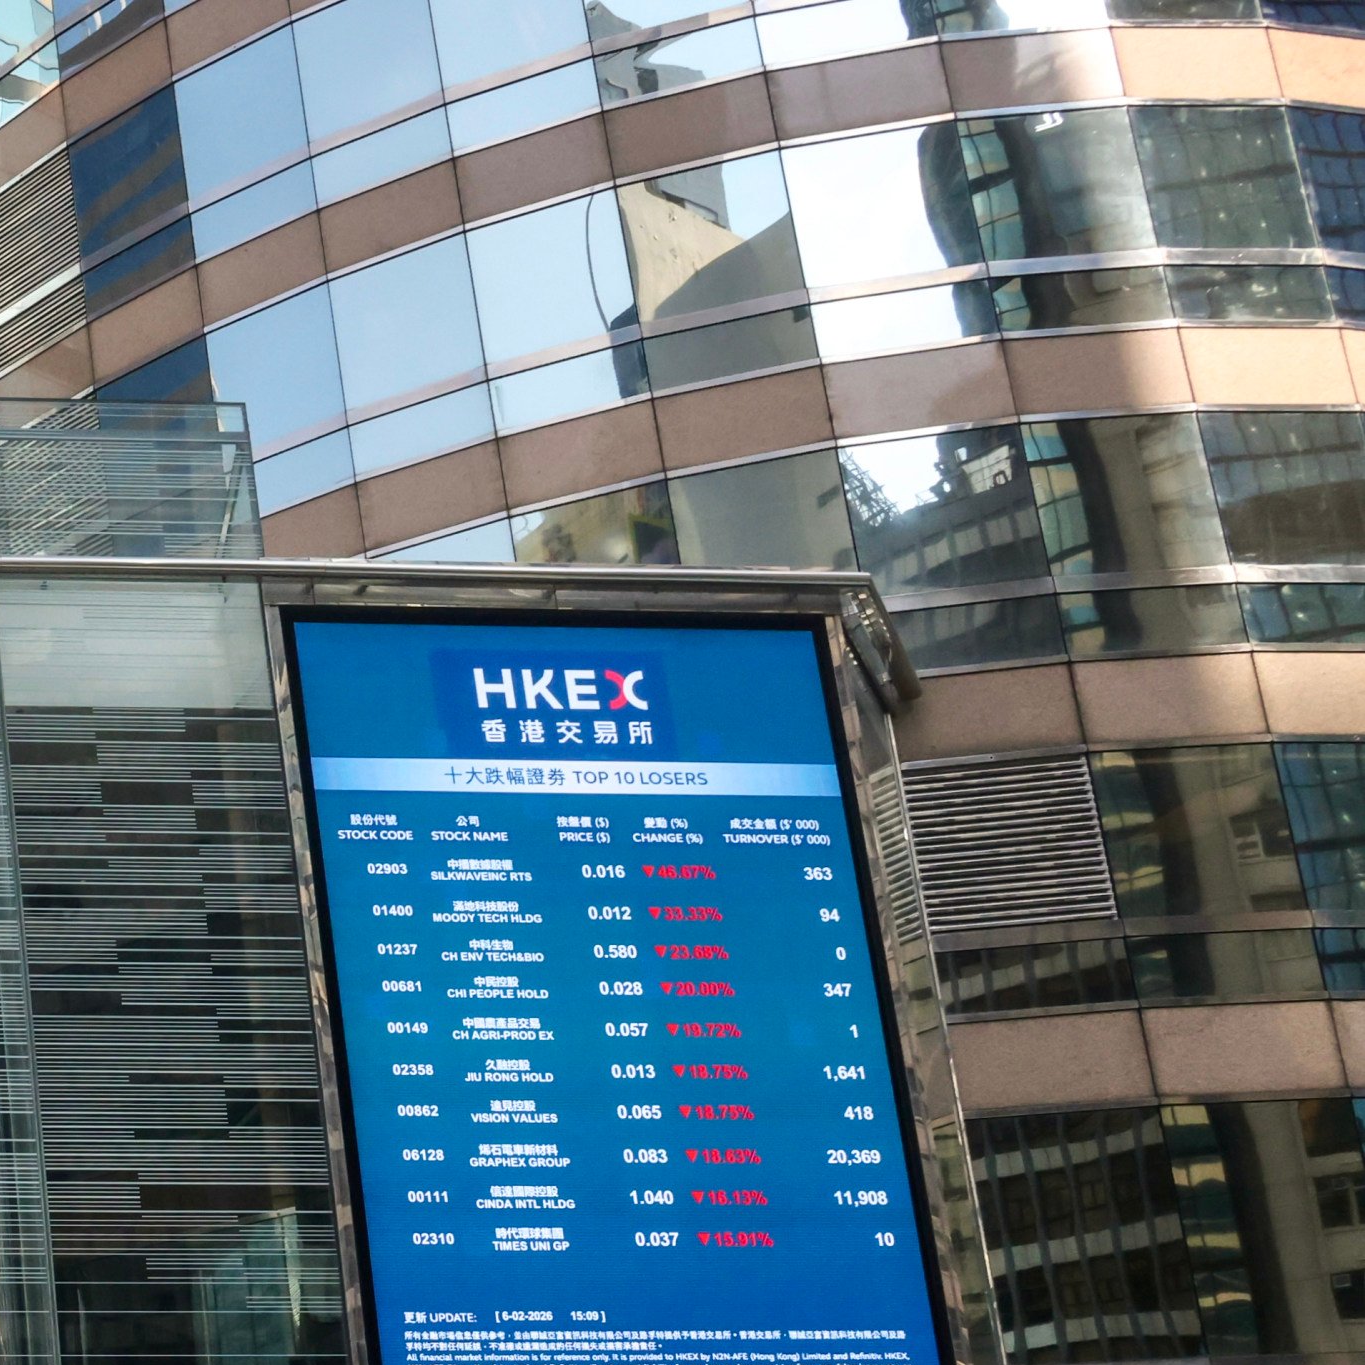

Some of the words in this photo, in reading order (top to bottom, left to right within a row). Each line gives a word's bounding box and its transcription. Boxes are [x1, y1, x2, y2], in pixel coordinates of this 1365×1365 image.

[473, 667, 648, 711] HKEX
[482, 719, 652, 744] 香港交易所
[444, 766, 565, 785] 十大跌幅證券
[573, 771, 608, 784] TOP
[615, 772, 634, 784] 10
[640, 772, 708, 785] LOSERS
[338, 830, 377, 839] STOCK
[380, 830, 413, 840] CODE
[431, 831, 470, 840] STOCK
[473, 832, 508, 841] NAME
[559, 832, 593, 842] PRICE
[633, 833, 683, 842] CHANGE
[723, 834, 788, 844] TURNOVER
[368, 863, 407, 874] 02903
[582, 865, 625, 878] 0.016
[804, 867, 832, 880] 363
[431, 871, 507, 881] SILKWAVEINC
[510, 872, 532, 881] RTS
[373, 905, 413, 916] 01400
[588, 906, 631, 920] 0.012
[433, 913, 475, 922] MOODY
[478, 914, 508, 922] TECH
[511, 914, 542, 923] HLDG
[378, 944, 417, 955] 01237
[594, 945, 637, 958] 0.580
[382, 981, 421, 992] 00681
[599, 981, 643, 995] 0.028
[824, 983, 851, 997] 347
[387, 1022, 428, 1033] 00149
[605, 1023, 648, 1036] 0.057
[393, 1064, 433, 1075] 02358
[611, 1064, 655, 1078] 0.013
[824, 1066, 865, 1081] 1,641
[465, 1072, 482, 1081] JIU
[485, 1072, 519, 1082] RONG
[522, 1073, 553, 1082] HOLD
[398, 1105, 438, 1116] 00862
[617, 1105, 661, 1119] 0.065
[844, 1106, 873, 1120] 418
[471, 1113, 509, 1122] VISION
[512, 1114, 558, 1123] VALUES
[403, 1149, 444, 1161] 06128
[624, 1149, 668, 1163] 0.083
[827, 1150, 881, 1165] 20,369
[470, 1157, 526, 1167] GRAPHEX
[529, 1158, 570, 1167] GROUP
[408, 1191, 448, 1202] 00111
[630, 1190, 673, 1204] 1.040
[834, 1191, 888, 1207] 11,908
[476, 1199, 513, 1208] CINDA
[515, 1199, 541, 1208] INTL
[543, 1199, 575, 1209] HLDG
[413, 1233, 454, 1244] 02310
[635, 1232, 678, 1246] 0.037
[492, 1241, 528, 1251] TIMES
[530, 1241, 550, 1251] UNI
[553, 1241, 569, 1251] GP
[430, 1313, 476, 1322] UPDATE:
[502, 1311, 553, 1321] 6-02-2026
[571, 1311, 599, 1320] 15:09
